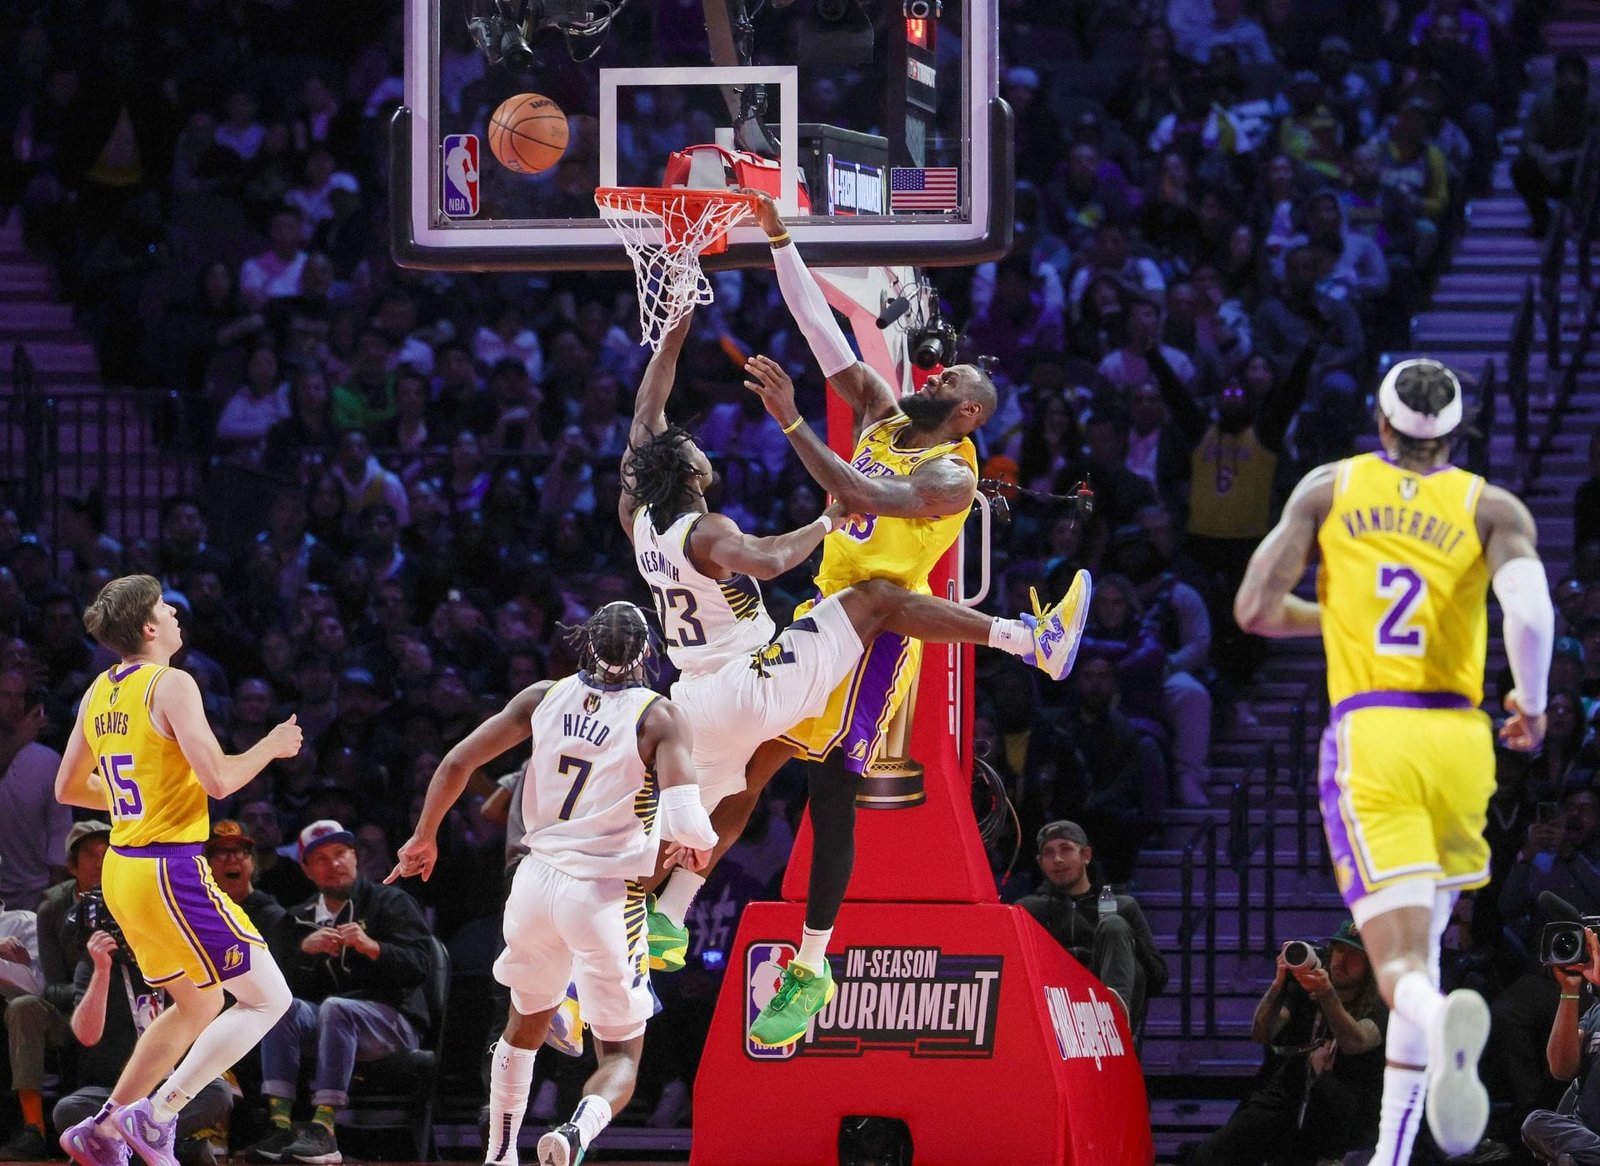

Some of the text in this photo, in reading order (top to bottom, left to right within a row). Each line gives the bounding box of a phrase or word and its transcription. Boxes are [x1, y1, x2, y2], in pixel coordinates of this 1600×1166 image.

[448, 198, 466, 211] NBA
[1341, 506, 1466, 553] VANDERBILT
[640, 550, 680, 582] NESMITH
[1376, 564, 1425, 653] 2
[95, 711, 129, 738] REAVES
[563, 713, 610, 747] HIELD
[100, 754, 144, 820] 15
[558, 754, 593, 821] 7
[845, 949, 938, 979] IN-SEASON
